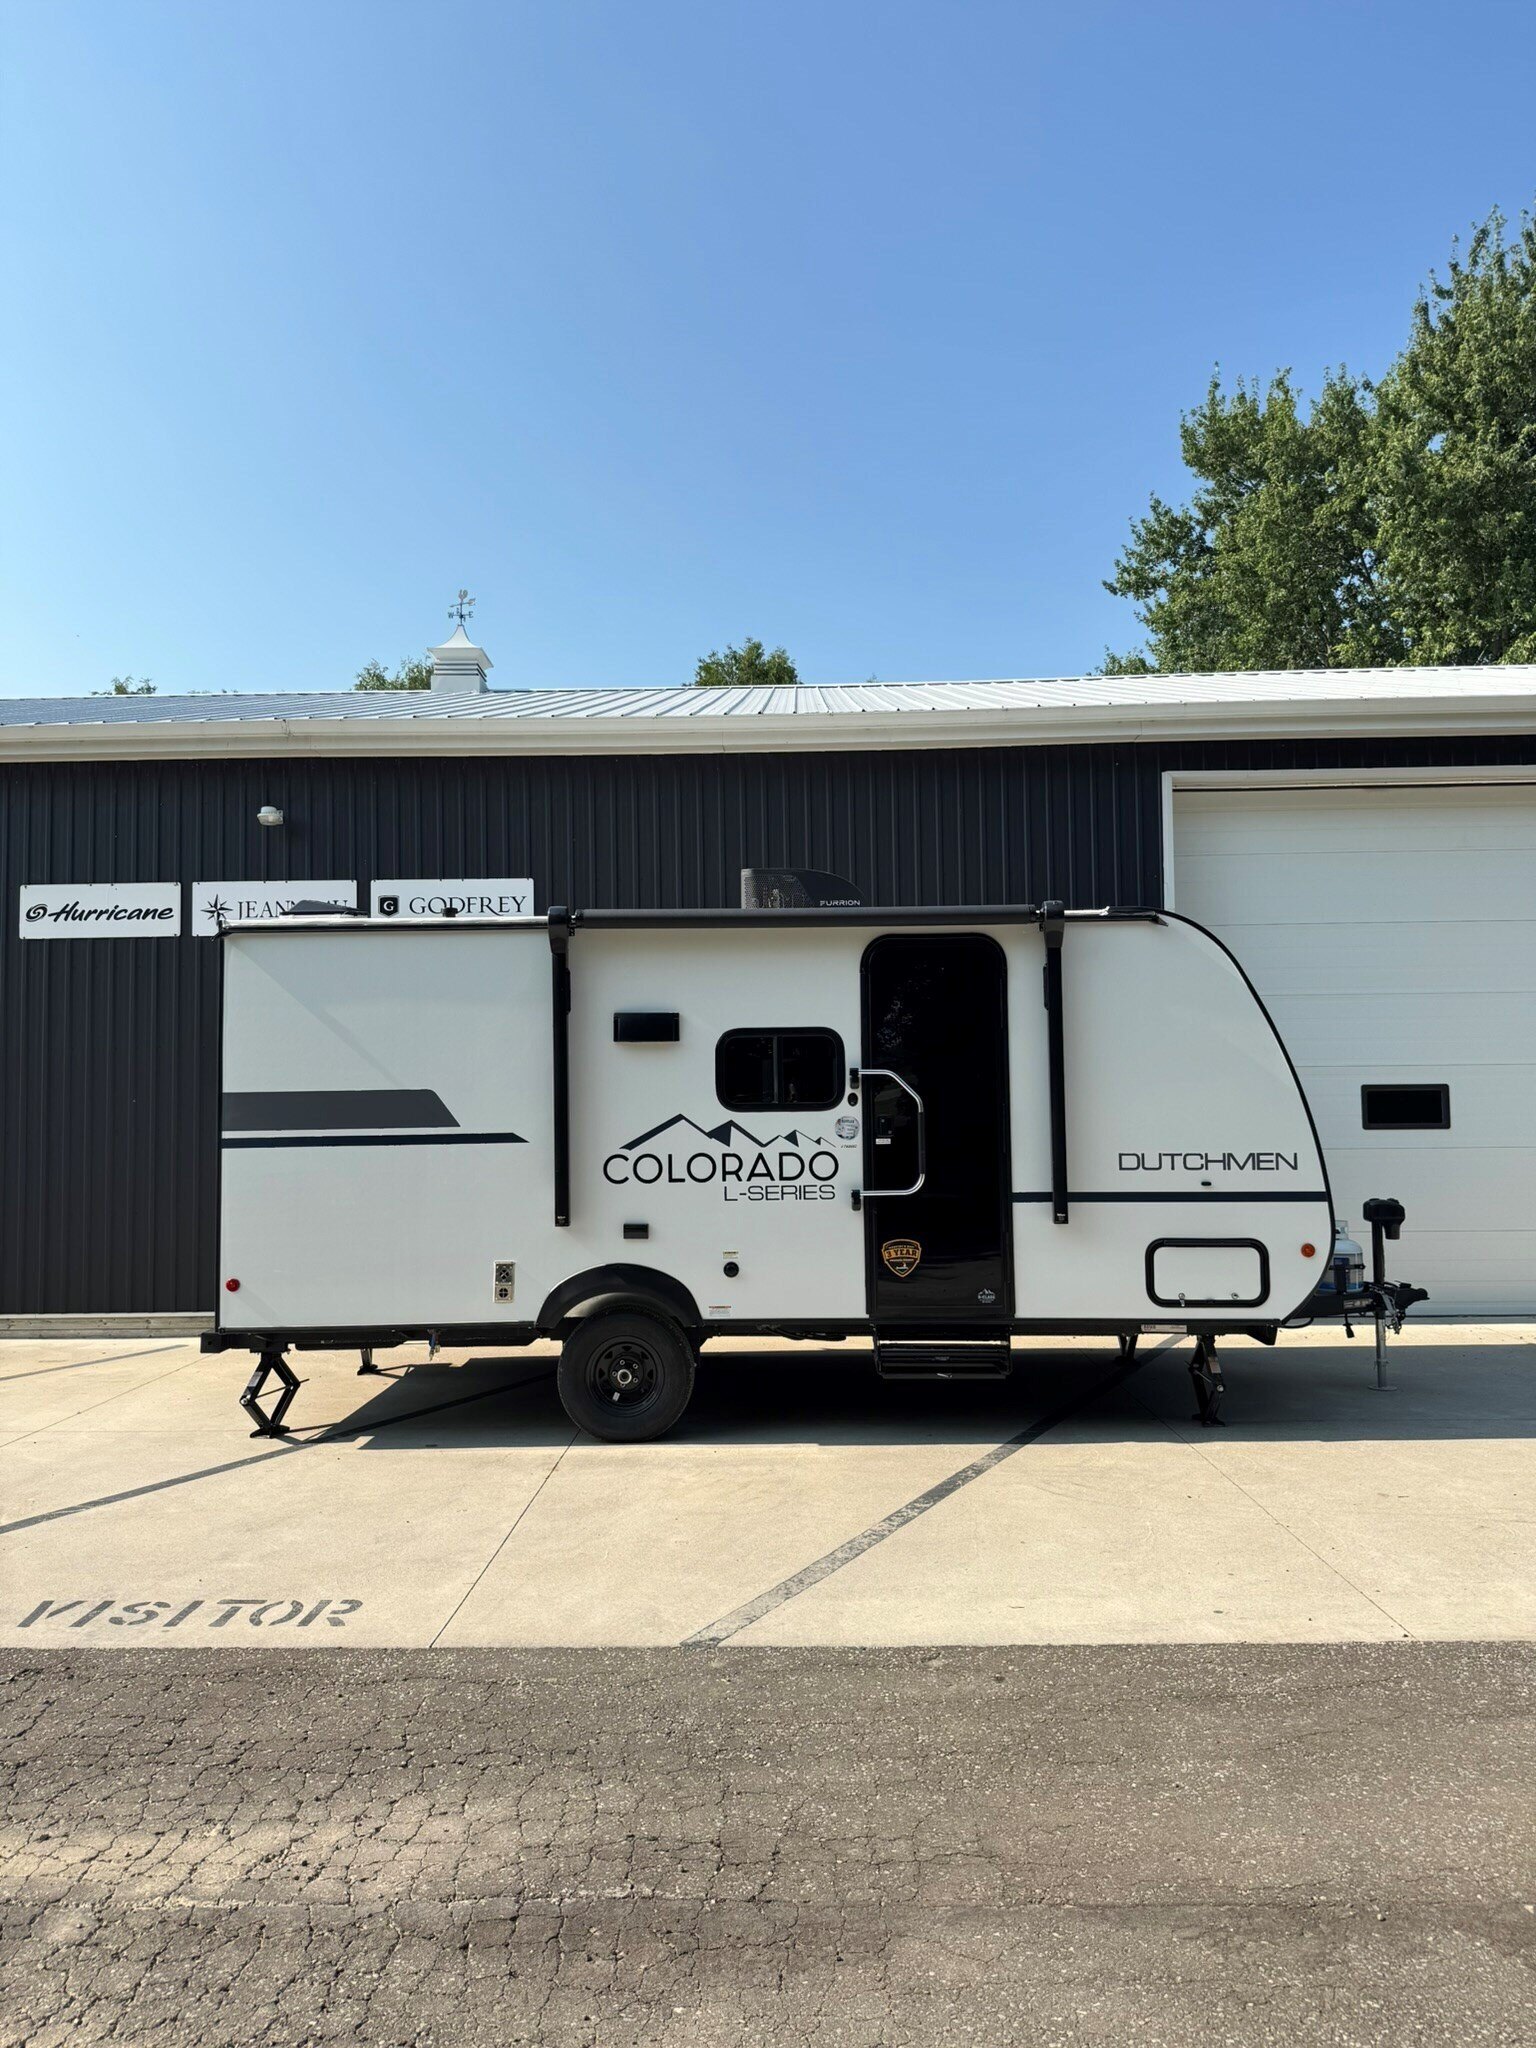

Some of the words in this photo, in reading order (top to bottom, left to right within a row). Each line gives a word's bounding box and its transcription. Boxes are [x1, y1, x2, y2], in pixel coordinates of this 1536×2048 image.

[48, 901, 174, 922] Hurricane
[409, 896, 527, 916] GODFREY
[603, 1151, 839, 1184] COLORADO
[1118, 1152, 1298, 1171] DUTCHMEN
[724, 1184, 836, 1202] L-SERIES
[894, 1248, 917, 1256] YEAR
[17, 1599, 363, 1628] VISITOR
